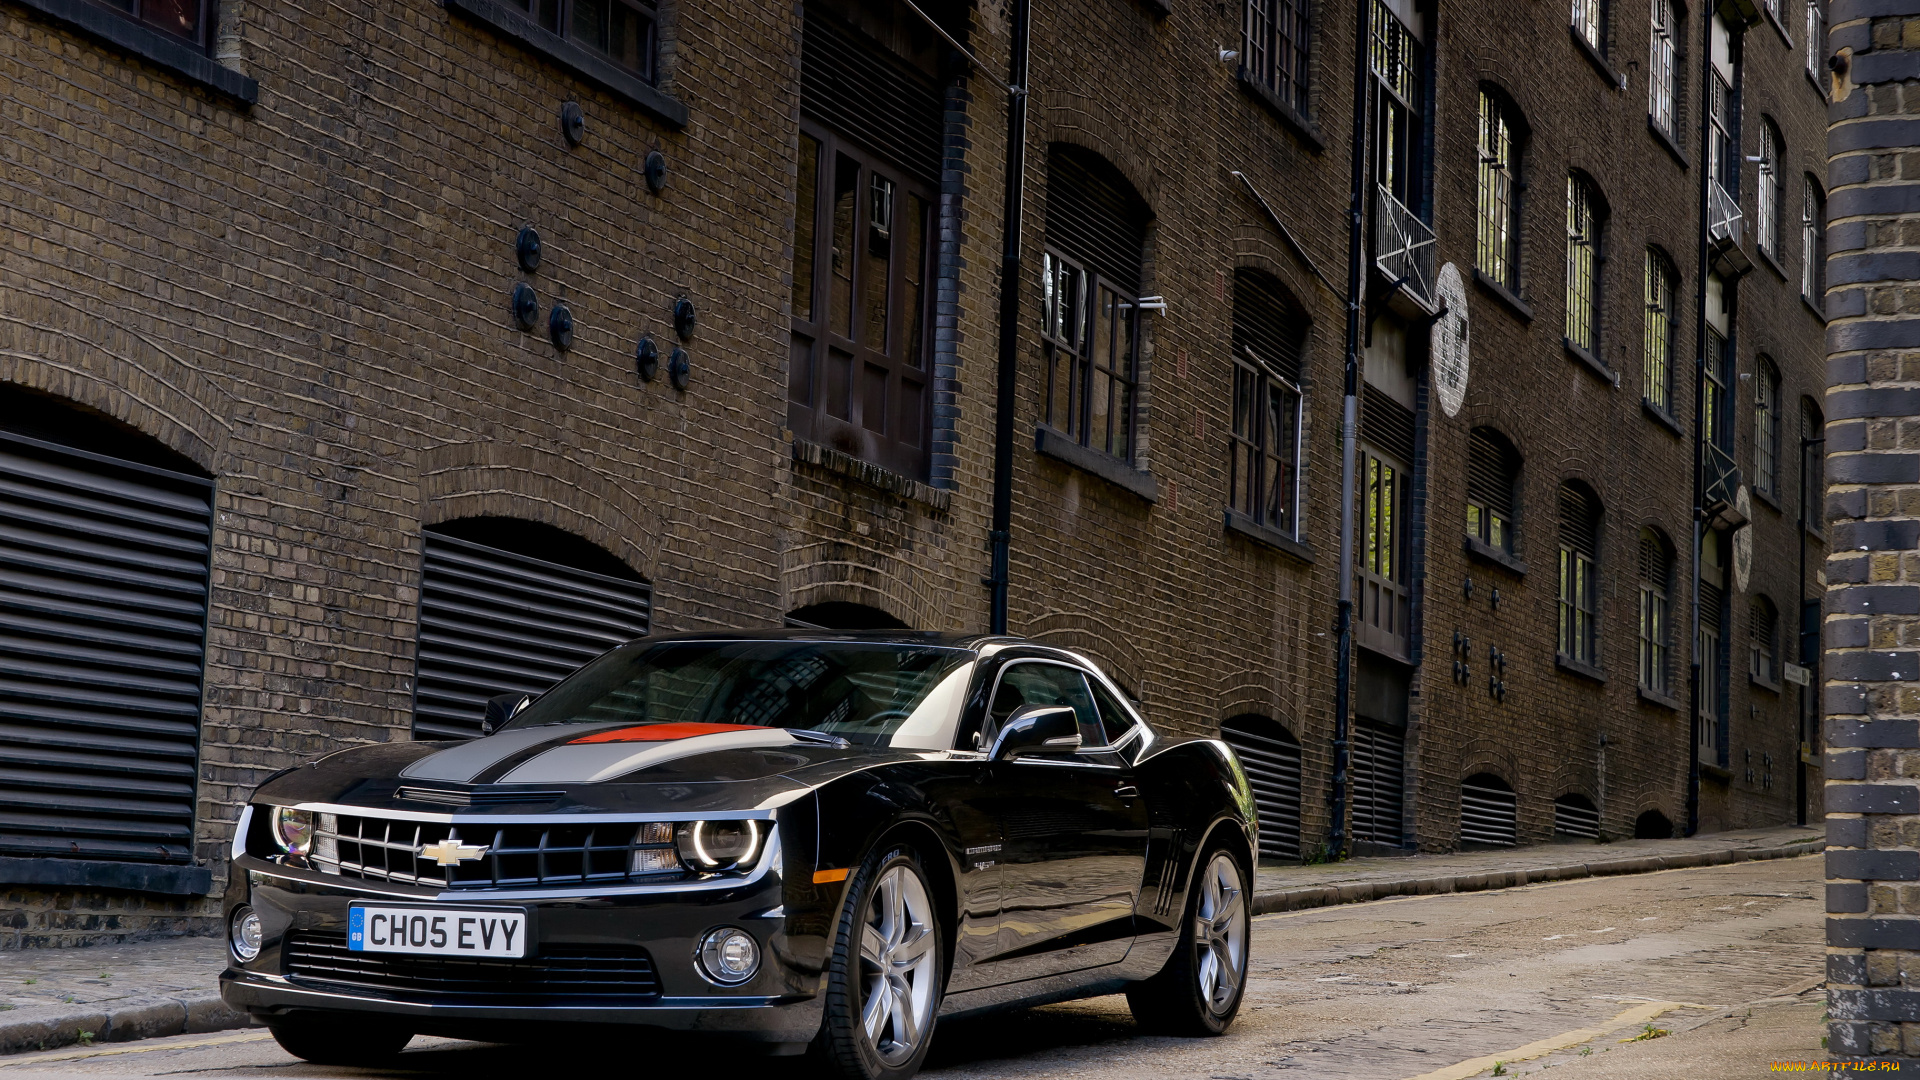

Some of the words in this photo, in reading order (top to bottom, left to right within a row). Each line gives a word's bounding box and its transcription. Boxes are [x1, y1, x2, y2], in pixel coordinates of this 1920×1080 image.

[351, 932, 362, 942] GB
[370, 914, 448, 948] CH05
[457, 917, 519, 951] EVY
